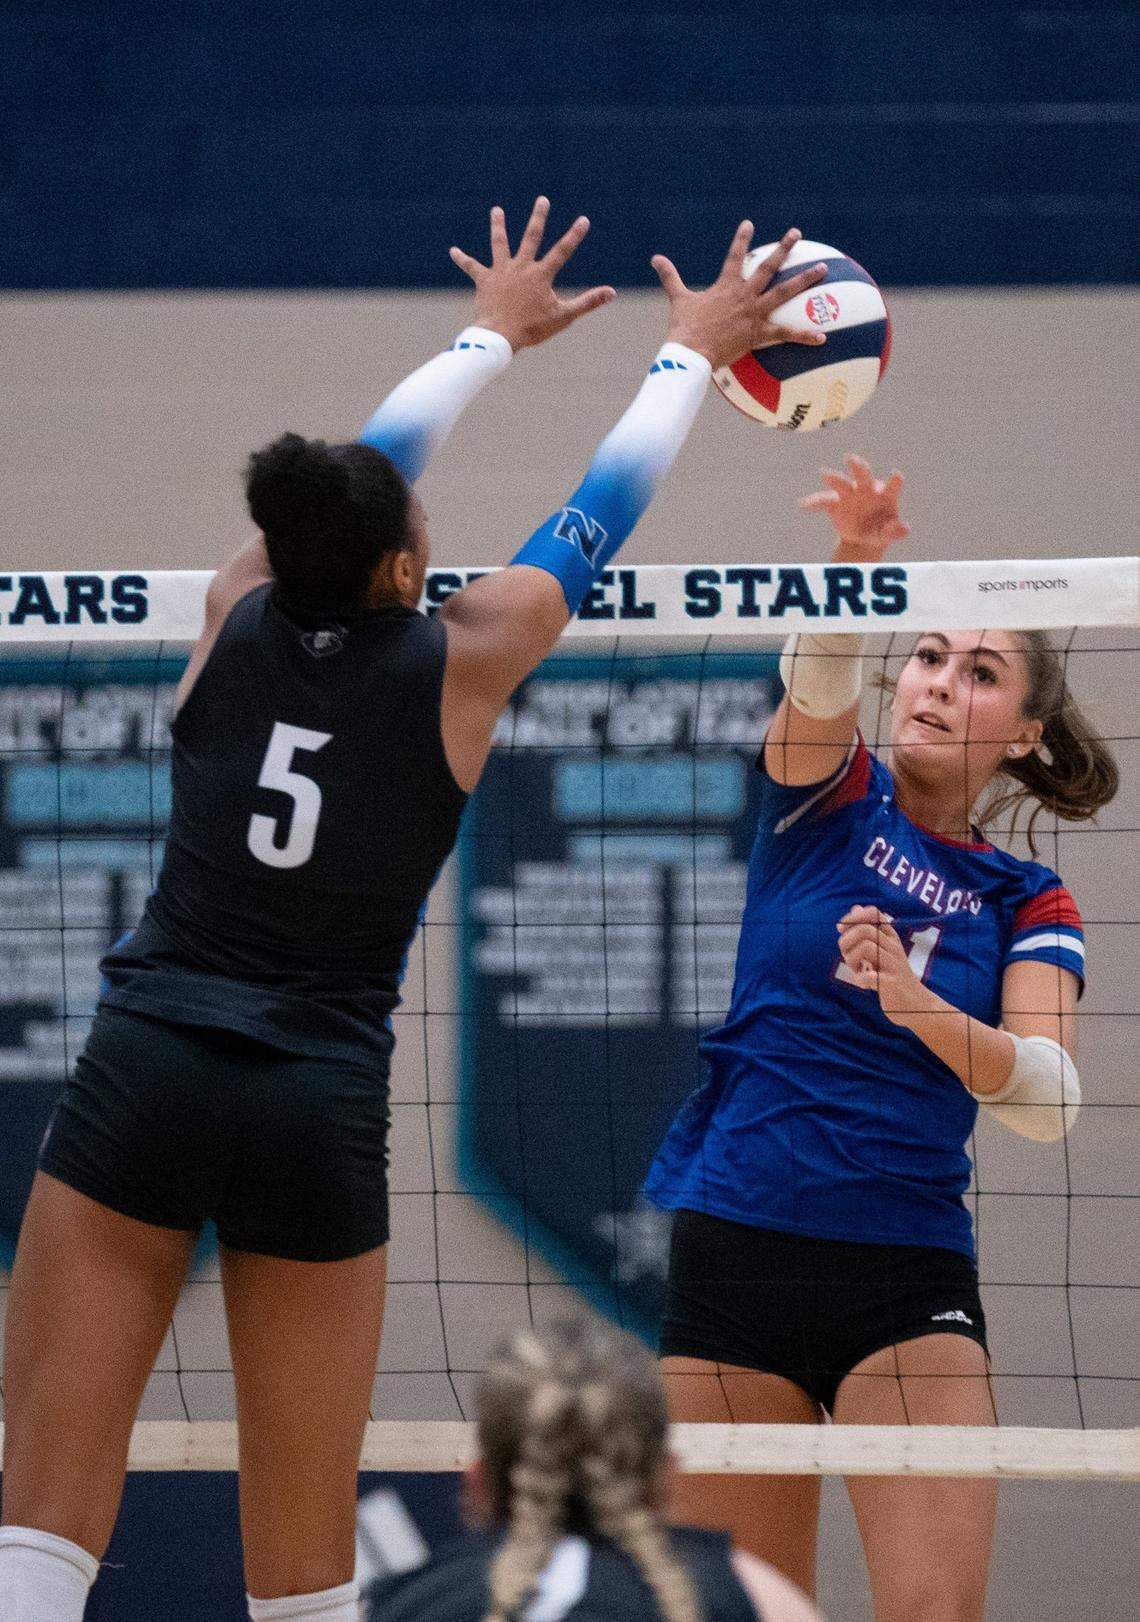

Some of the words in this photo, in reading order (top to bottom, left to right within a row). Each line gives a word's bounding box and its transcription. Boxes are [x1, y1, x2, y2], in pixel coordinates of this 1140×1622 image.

[553, 507, 608, 568] N
[0, 575, 148, 625] ARS
[685, 567, 908, 618] STARS
[247, 721, 334, 869] 5
